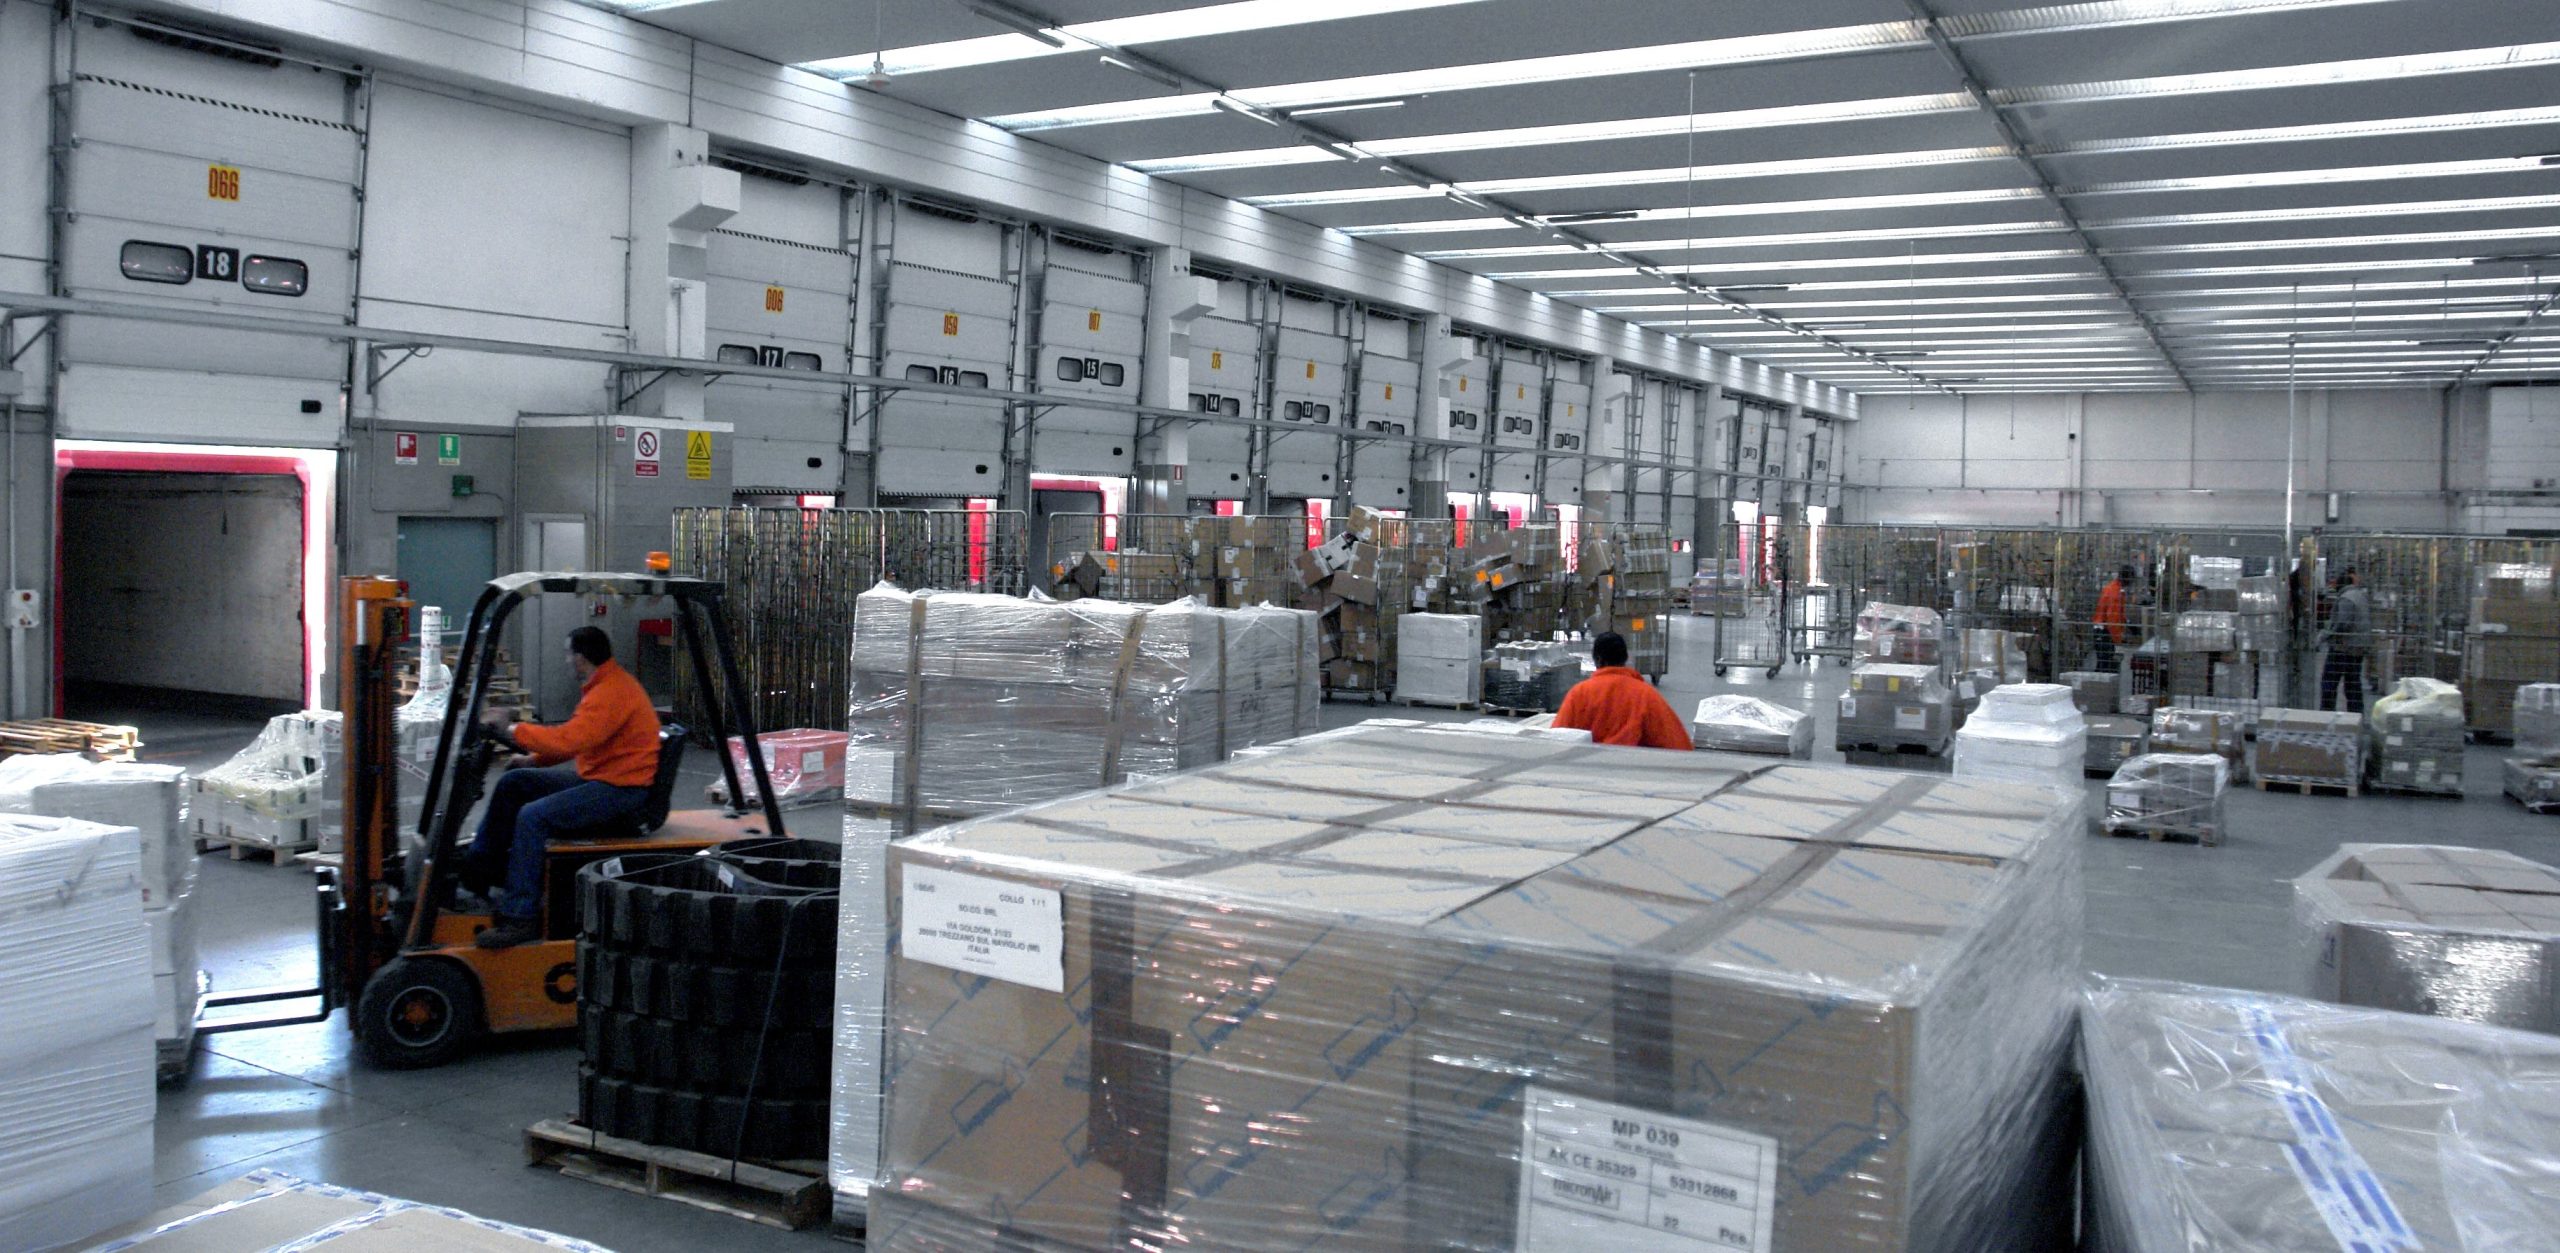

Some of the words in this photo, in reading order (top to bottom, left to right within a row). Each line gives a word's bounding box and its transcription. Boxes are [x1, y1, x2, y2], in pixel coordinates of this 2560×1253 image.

[209, 168, 238, 199] 066
[206, 250, 230, 276] 18
[765, 349, 779, 367] 17
[1086, 360, 1097, 376] 15
[943, 369, 954, 385] 16
[1210, 396, 1218, 411] 14
[999, 893, 1024, 905] COLLO
[967, 944, 990, 955] ITALIA
[1612, 1119, 1641, 1138] MP
[1645, 1127, 1680, 1148] 039
[1550, 1149, 1569, 1164] AK
[1572, 1153, 1592, 1170] CE
[1595, 1158, 1637, 1179] 35329
[1664, 1215, 1679, 1230] 22
